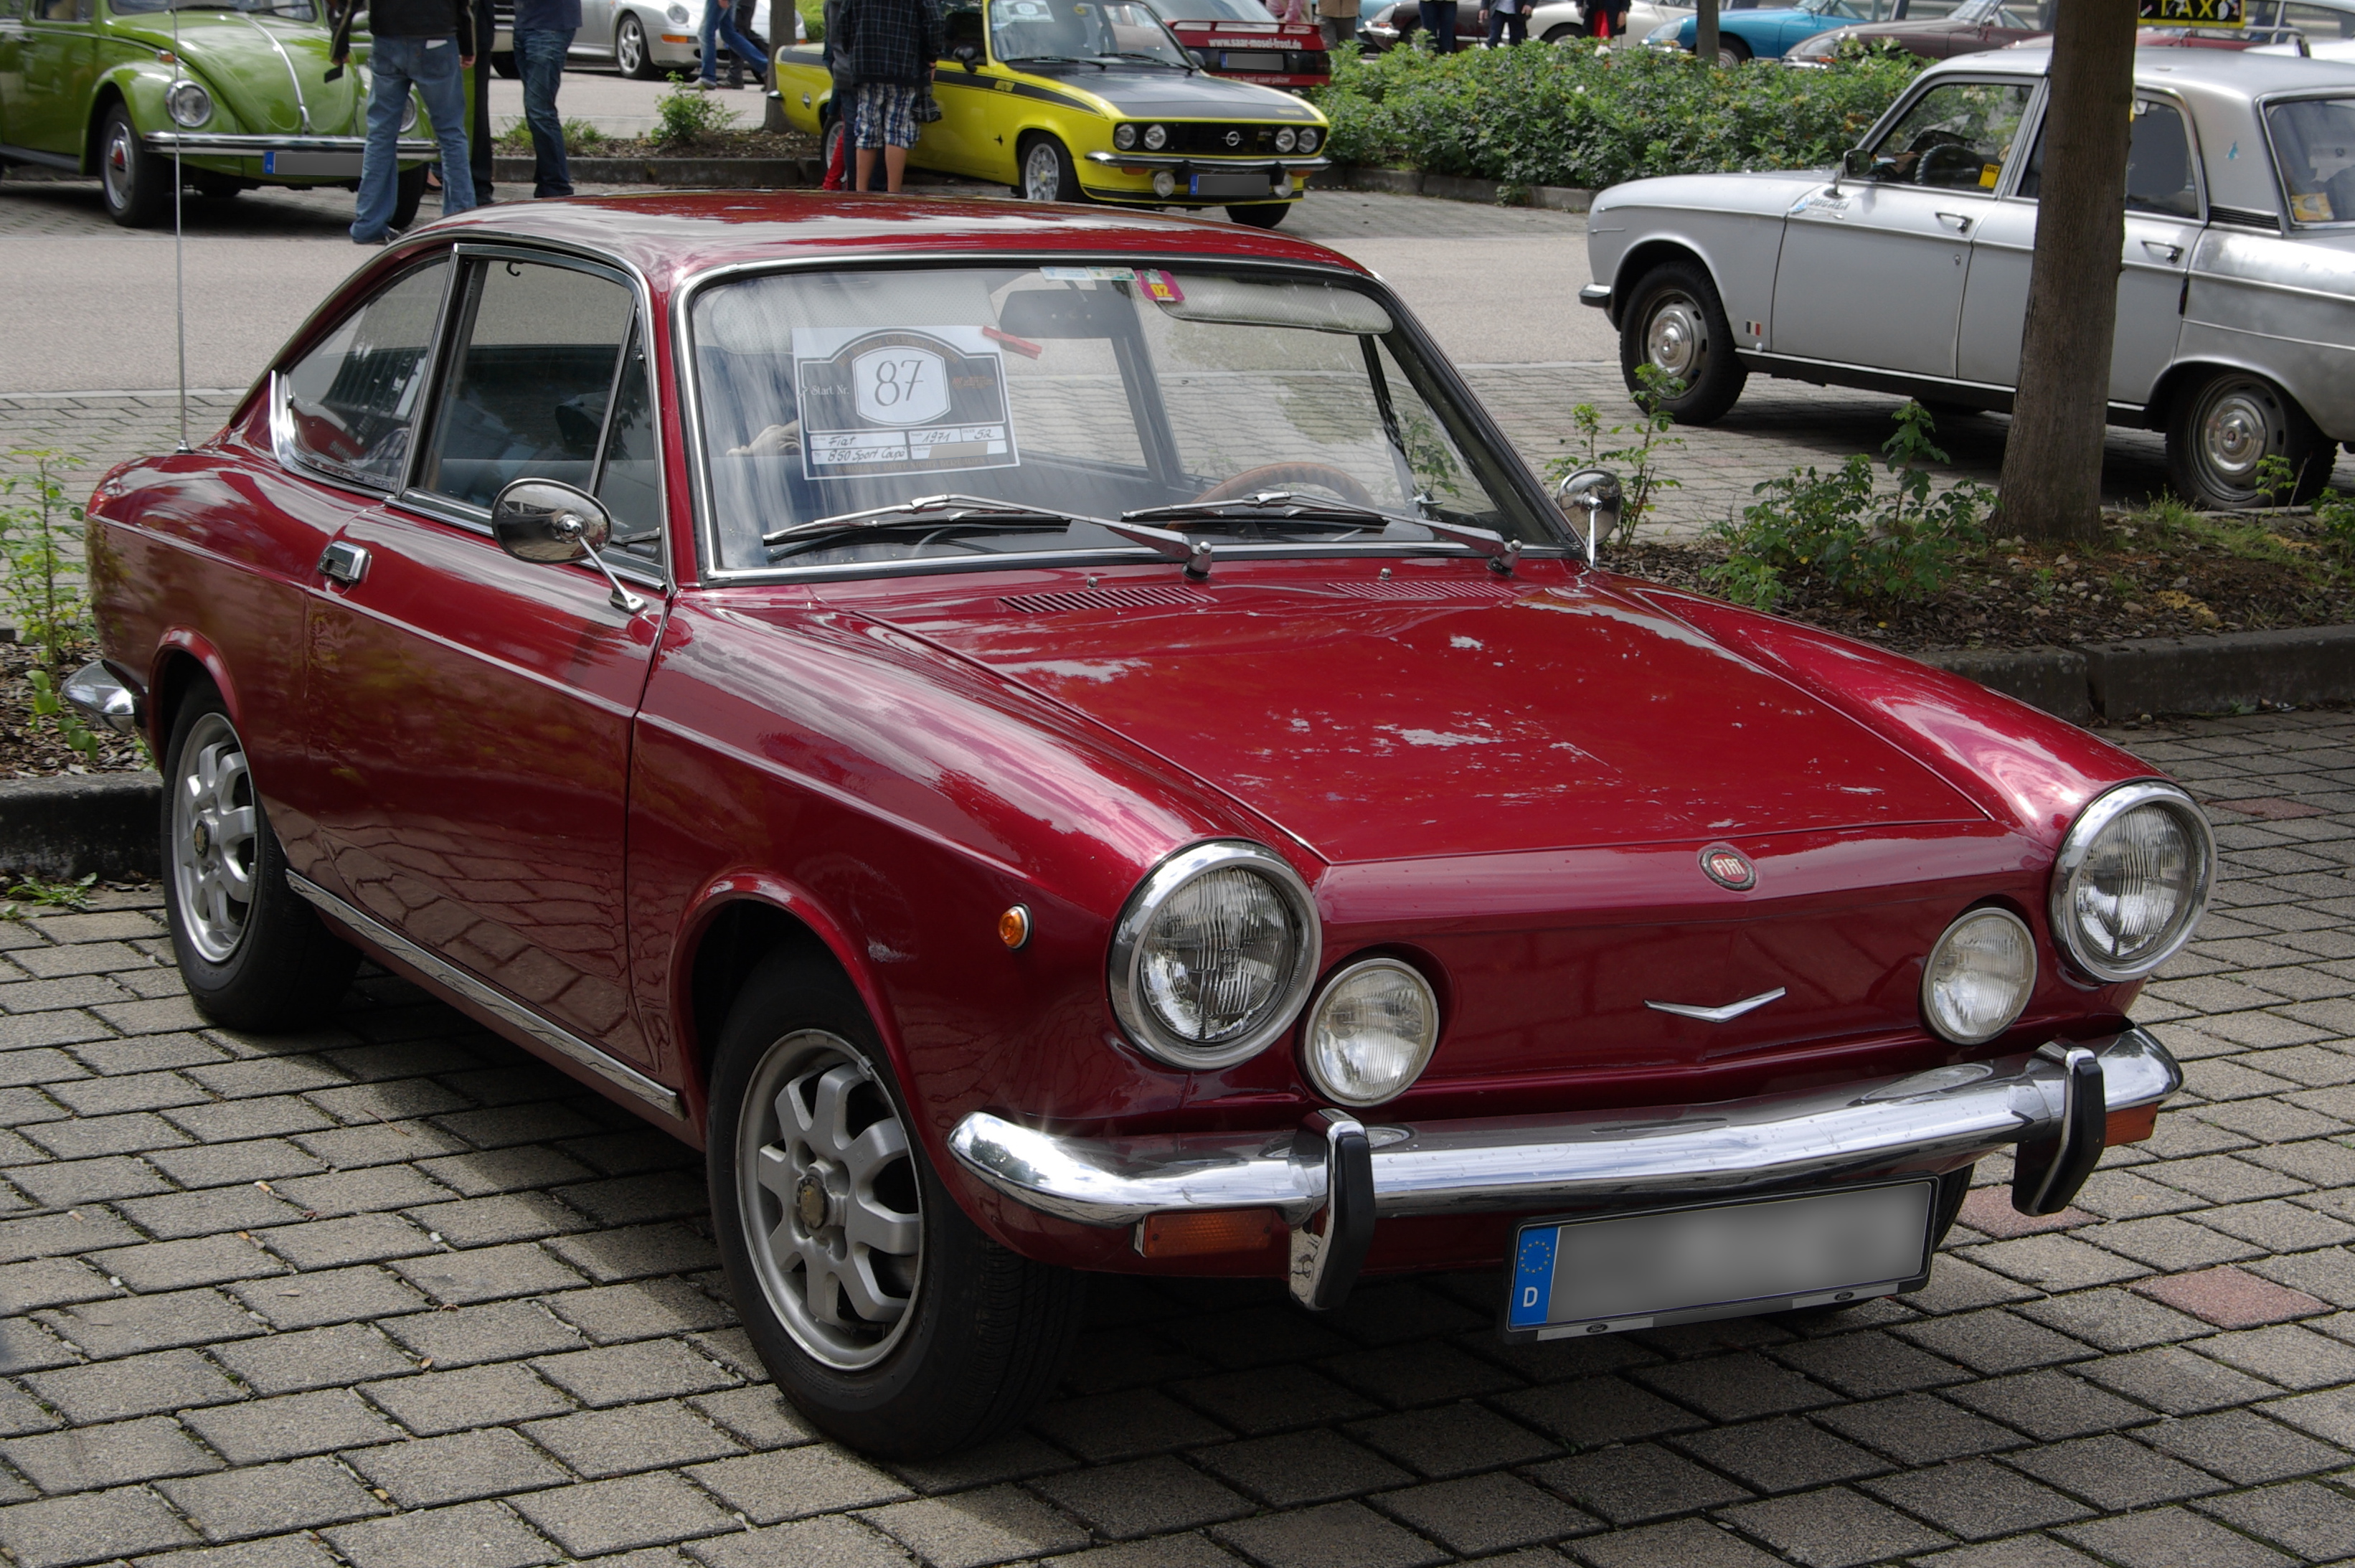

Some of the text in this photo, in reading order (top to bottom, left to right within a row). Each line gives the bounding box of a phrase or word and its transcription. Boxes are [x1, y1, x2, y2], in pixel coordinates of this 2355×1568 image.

[2161, 0, 2227, 18] TAX
[810, 384, 850, 396] Start Nr.
[874, 360, 924, 406] 87
[829, 435, 856, 447] Fiat
[922, 431, 951, 443] 1971
[973, 429, 995, 440] 52
[827, 449, 851, 462] 850
[851, 448, 879, 463] Sport
[1712, 858, 1745, 877] FIAT
[1523, 1286, 1539, 1308] D
